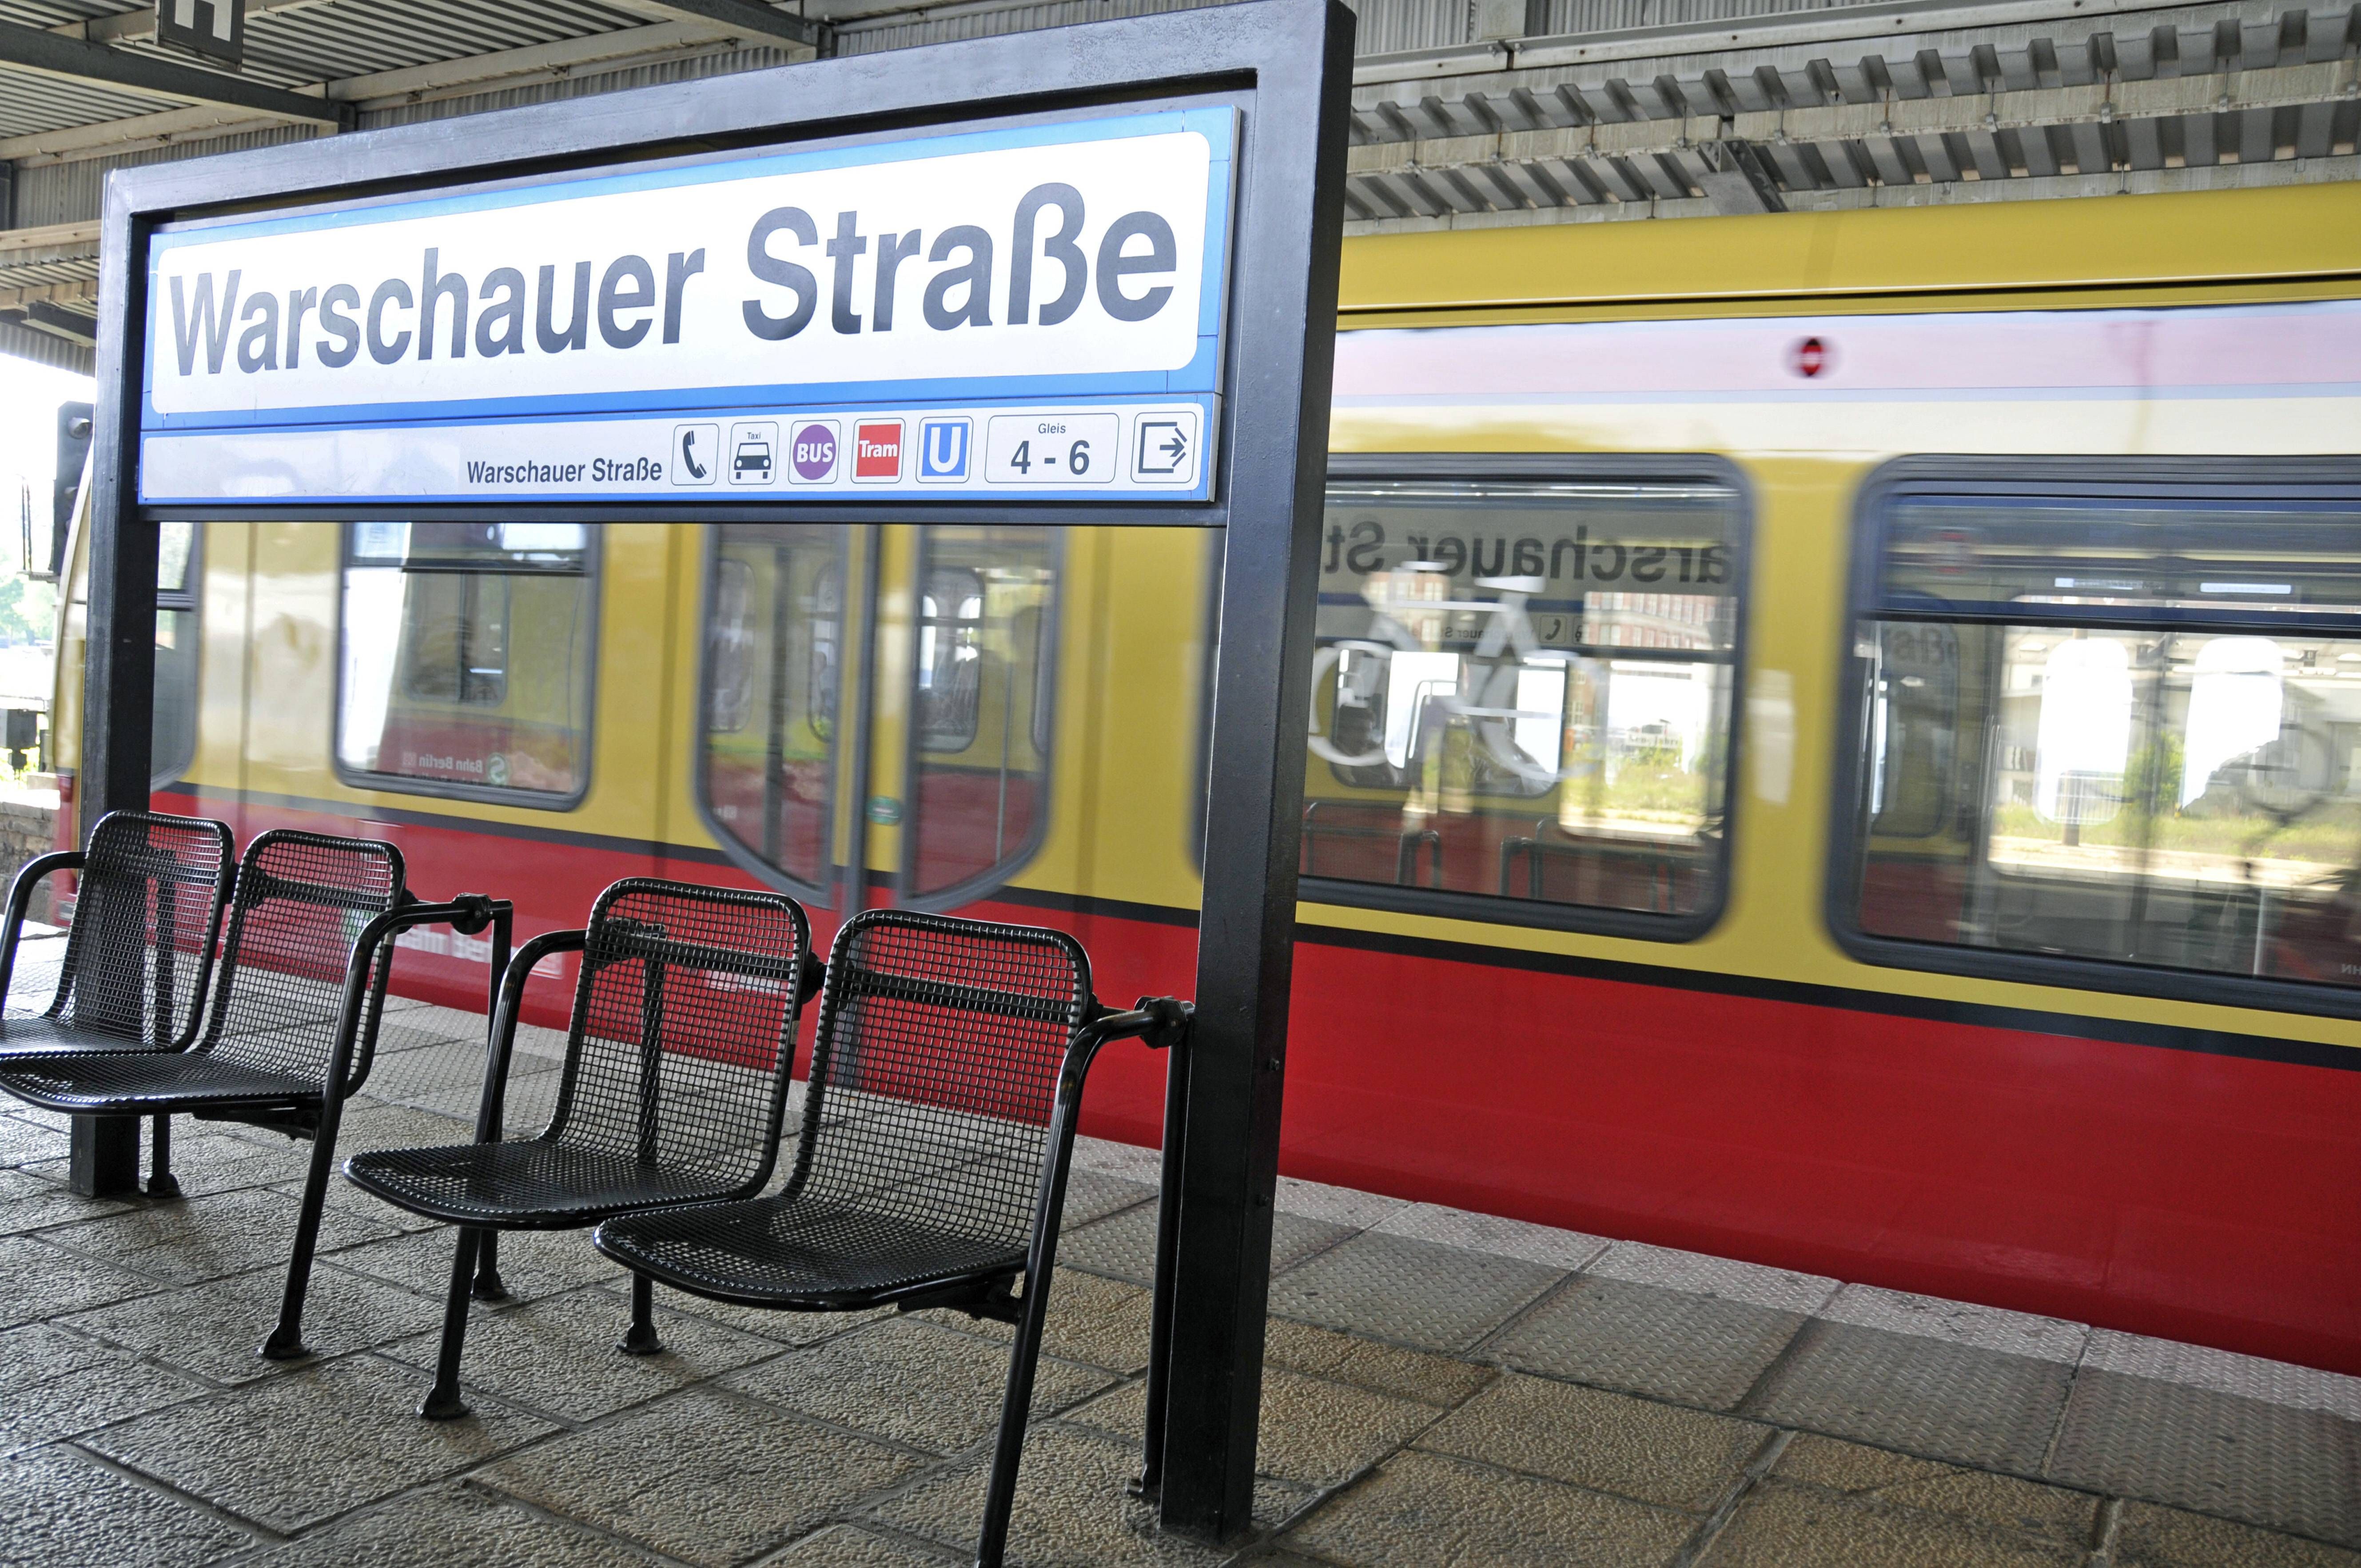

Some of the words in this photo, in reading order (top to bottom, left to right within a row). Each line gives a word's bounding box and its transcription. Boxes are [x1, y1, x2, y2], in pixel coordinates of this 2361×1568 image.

[169, 247, 705, 377] Warschauer
[741, 181, 1177, 341] Straße
[747, 431, 761, 440] Taxi
[1038, 423, 1066, 434] Gleis
[796, 442, 833, 463] BUS
[859, 439, 899, 458] Tram
[928, 426, 962, 473] U
[1010, 440, 1031, 474] 4
[1069, 439, 1090, 475] 6
[467, 460, 586, 483] Warschauer
[592, 457, 662, 482] Straße
